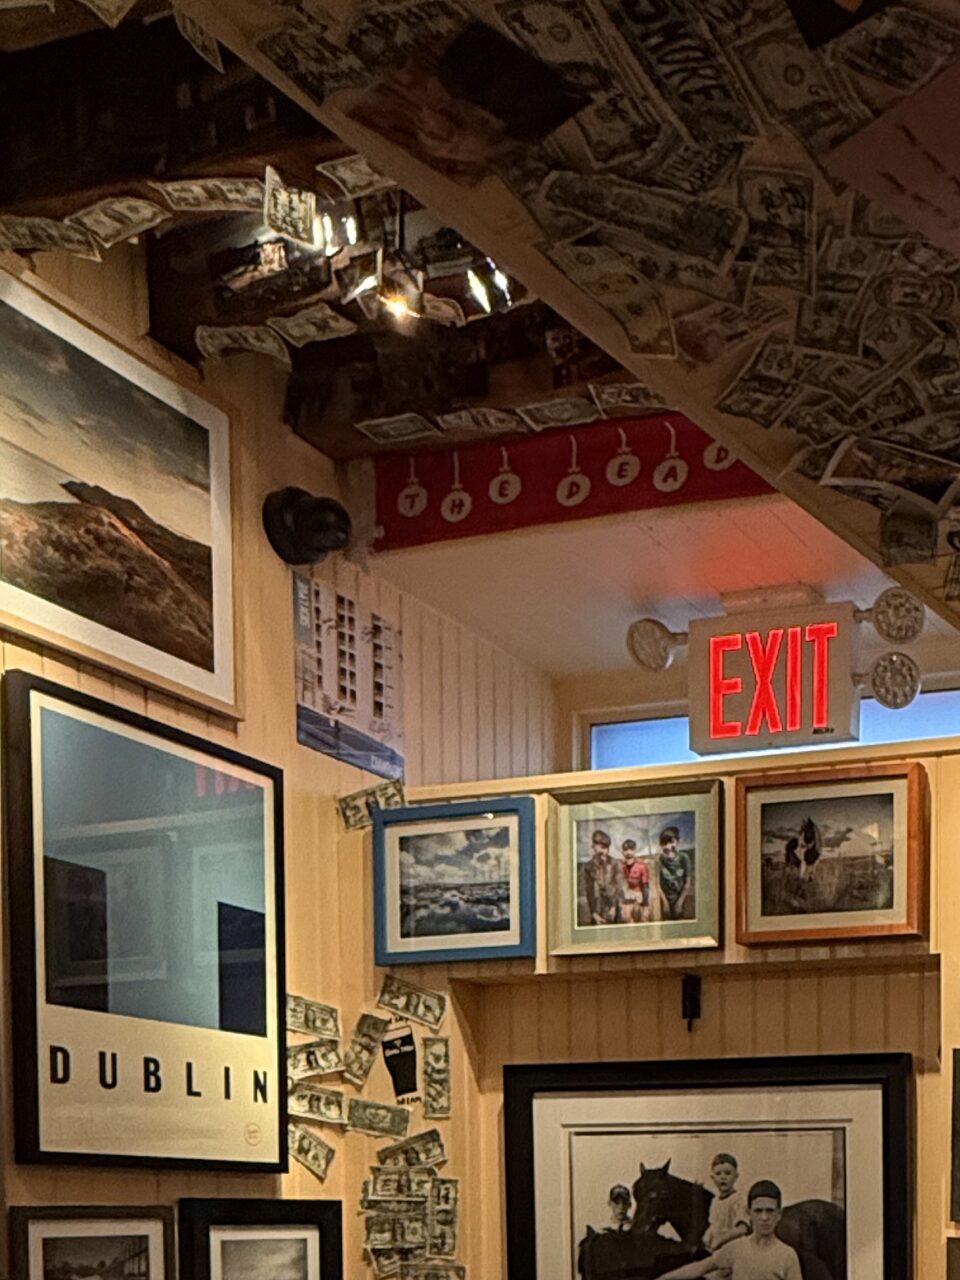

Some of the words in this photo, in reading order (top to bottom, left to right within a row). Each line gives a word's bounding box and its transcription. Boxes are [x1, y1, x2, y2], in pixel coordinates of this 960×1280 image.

[405, 478, 510, 514] THE
[567, 445, 730, 499] DEAD
[709, 621, 838, 739] EXIT
[49, 1044, 268, 1103] DUBLIN
